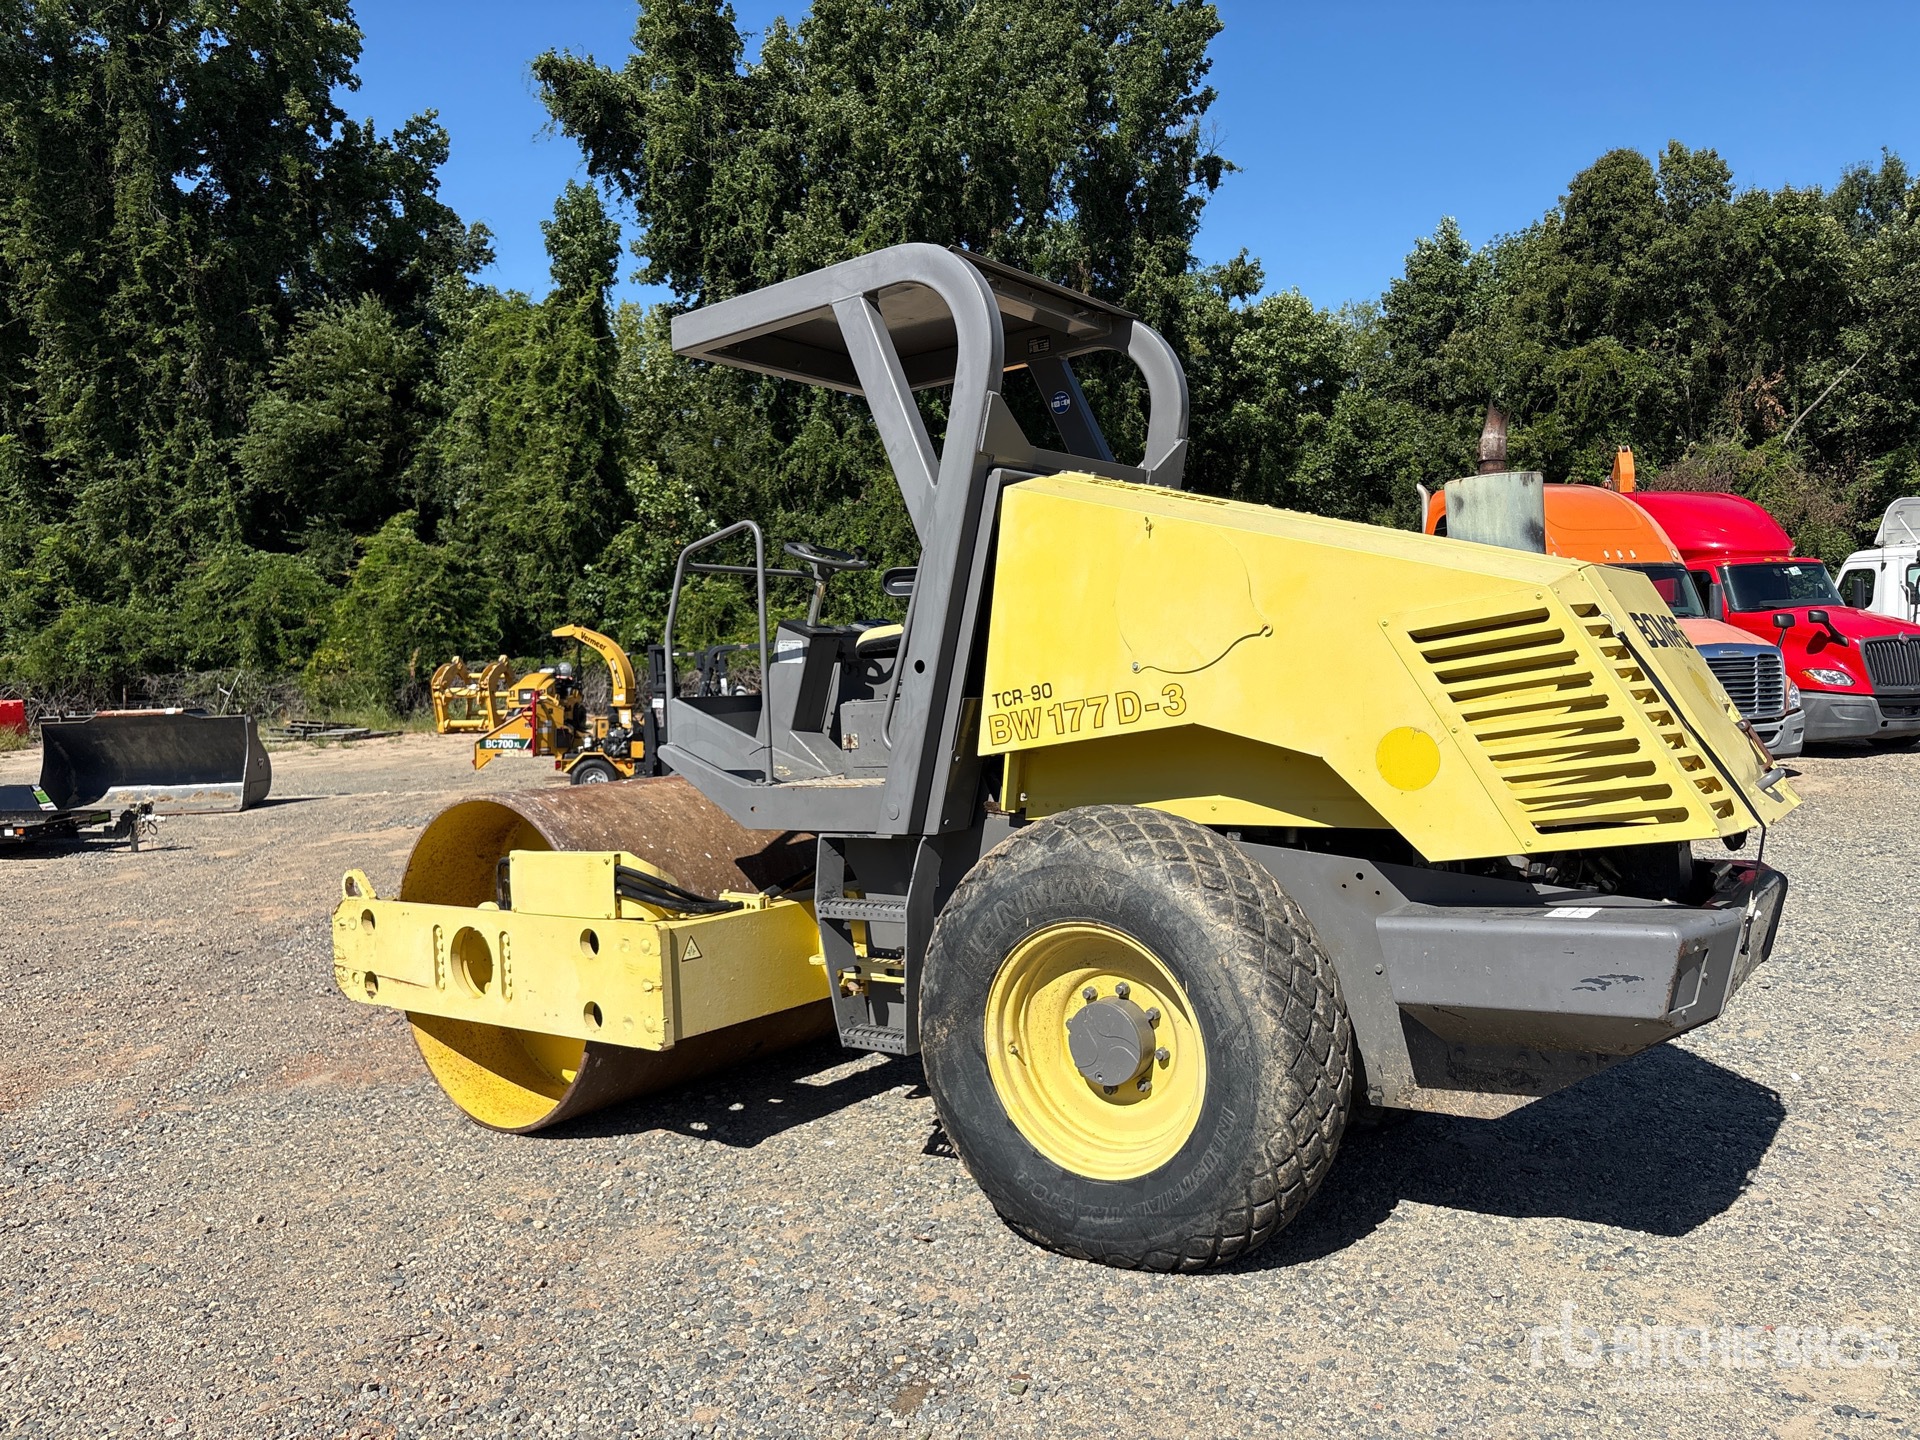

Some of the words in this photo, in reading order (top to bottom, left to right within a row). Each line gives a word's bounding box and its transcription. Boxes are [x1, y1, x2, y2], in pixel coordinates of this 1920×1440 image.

[580, 631, 607, 651] Vermeer
[988, 707, 1042, 746] BW
[1047, 694, 1109, 735] 177
[1115, 683, 1187, 725] D-3
[992, 682, 1053, 709] TCR-90
[485, 739, 514, 749] BC700
[1133, 1106, 1236, 1220] INDUSTRIAL
[1014, 1170, 1122, 1223] TRACTOR
